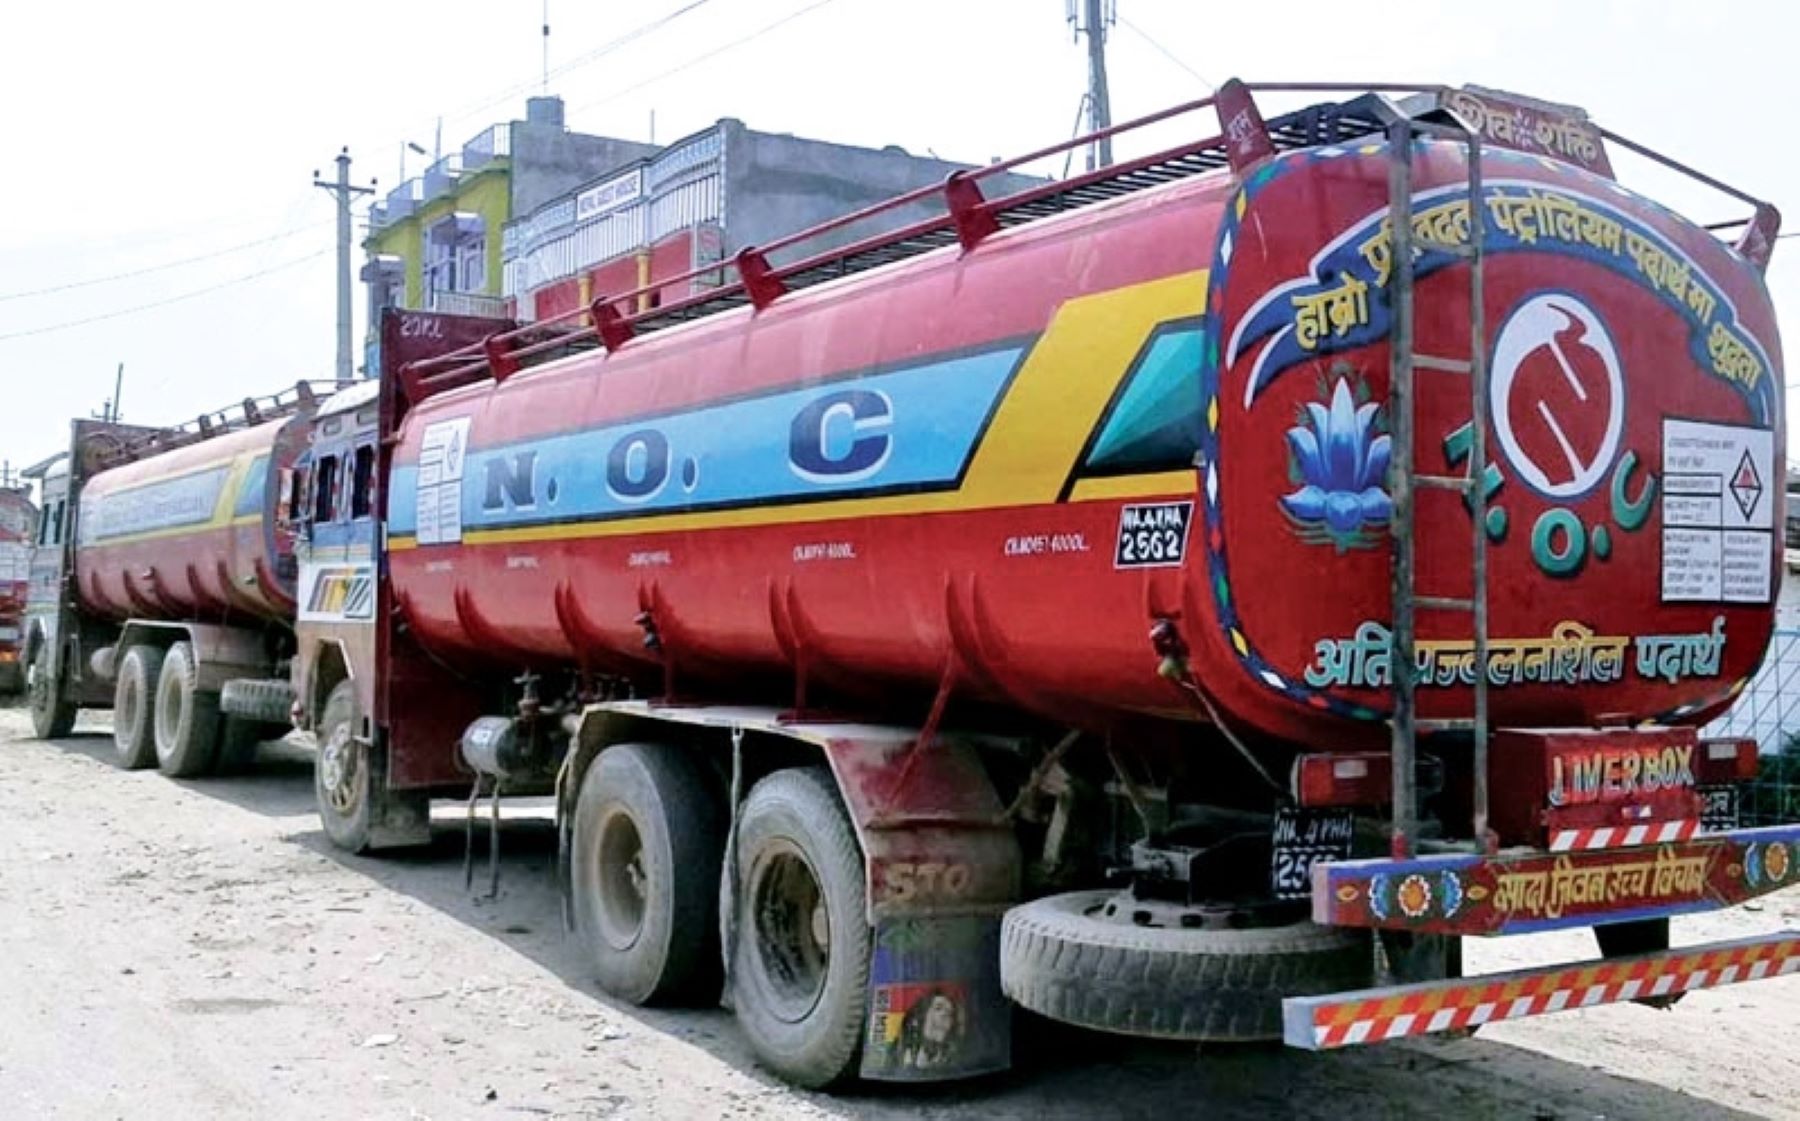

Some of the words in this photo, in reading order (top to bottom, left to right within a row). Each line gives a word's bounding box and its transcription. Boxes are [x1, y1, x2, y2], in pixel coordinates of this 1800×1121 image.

[1290, 270, 1368, 349] हाम्रो
[788, 386, 893, 484] C
[1121, 530, 1180, 561] 2562
[1304, 620, 1394, 687] अति
[1635, 615, 1726, 684] पदार्थ
